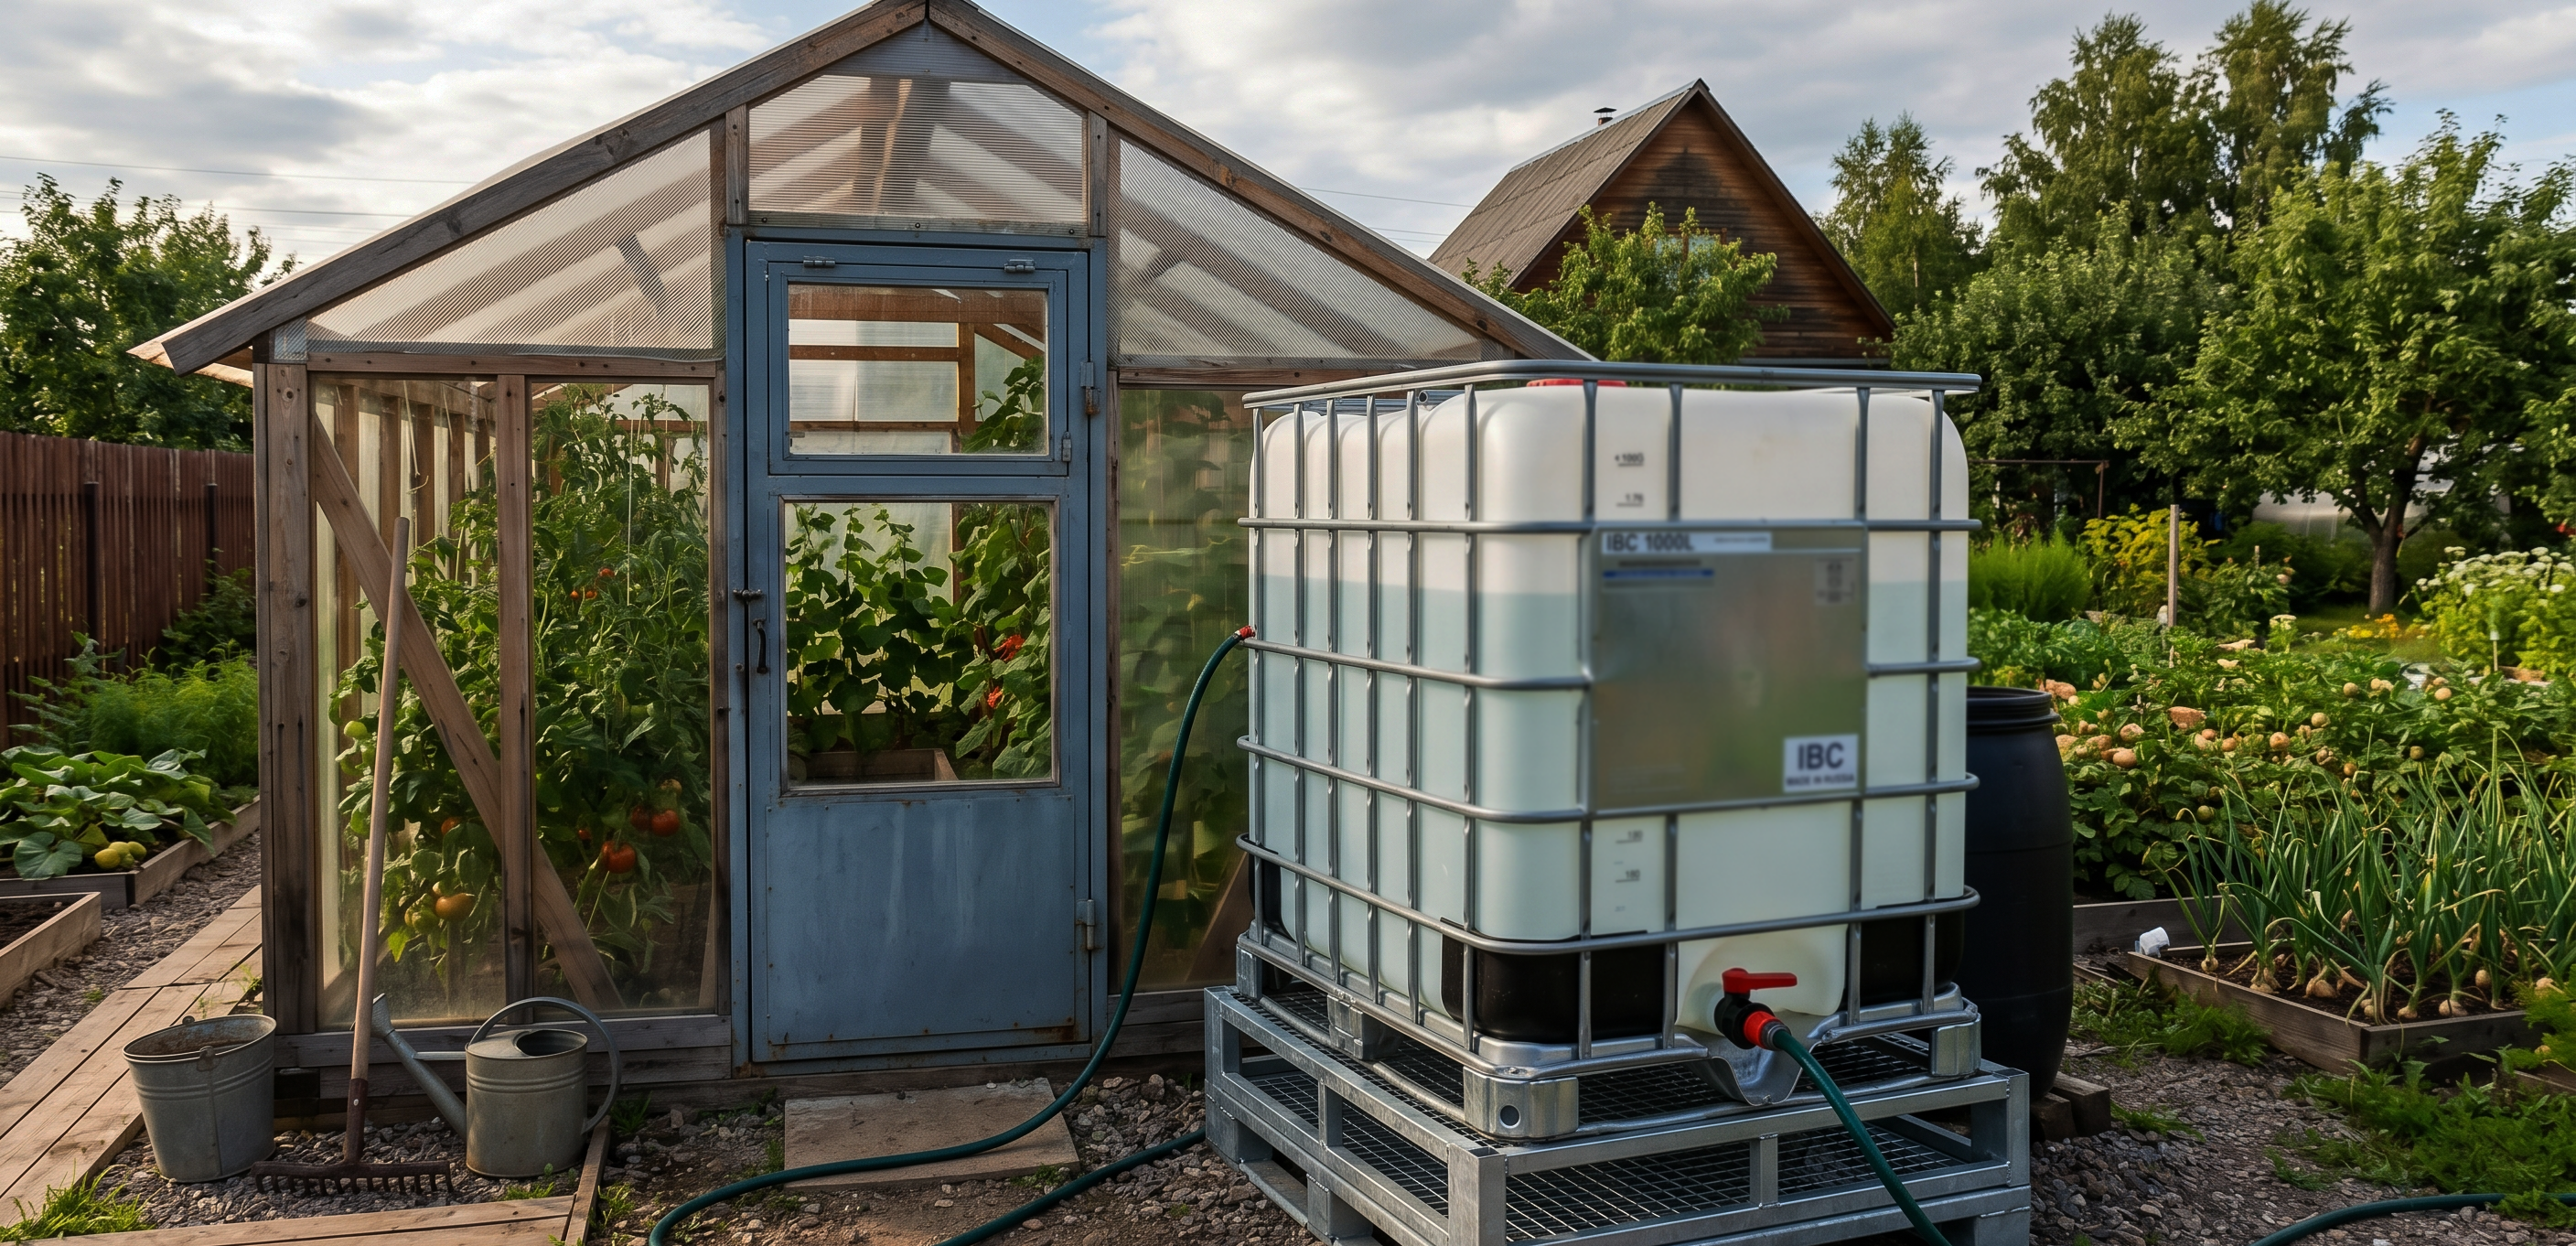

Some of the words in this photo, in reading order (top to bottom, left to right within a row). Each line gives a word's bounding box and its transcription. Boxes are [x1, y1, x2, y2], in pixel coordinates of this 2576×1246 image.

[1606, 533, 1637, 551] IBC
[1645, 533, 1694, 551] 1000L
[1798, 742, 1843, 770] IBC
[1814, 776, 1822, 784] IN
